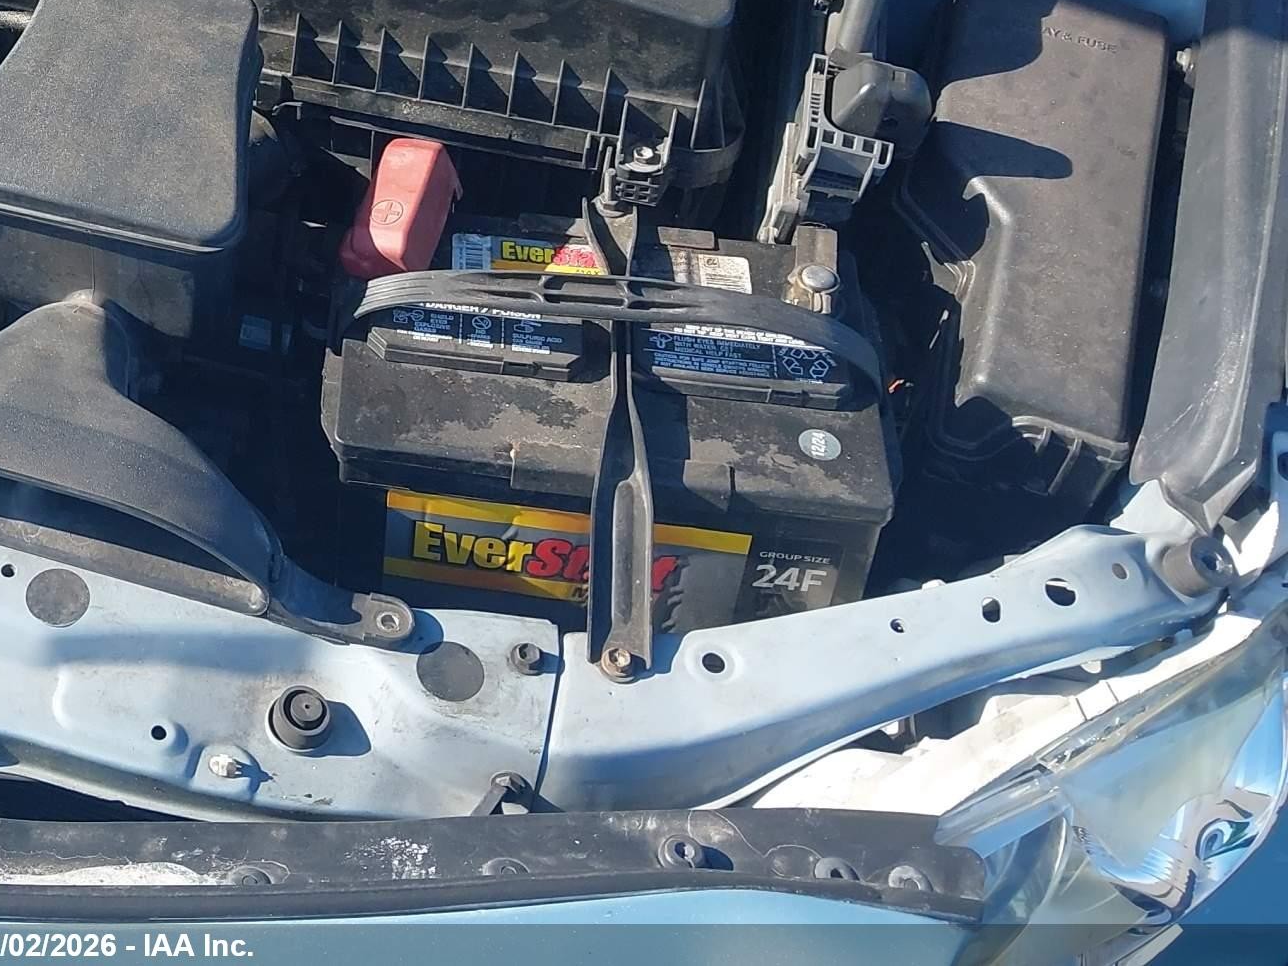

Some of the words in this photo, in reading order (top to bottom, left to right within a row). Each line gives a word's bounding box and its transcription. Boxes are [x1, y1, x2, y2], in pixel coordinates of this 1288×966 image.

[1078, 35, 1118, 53] FUSE
[811, 432, 826, 457] 12/24
[759, 551, 802, 561] GROUP
[803, 555, 831, 565] SIZE
[752, 564, 827, 592] 24F
